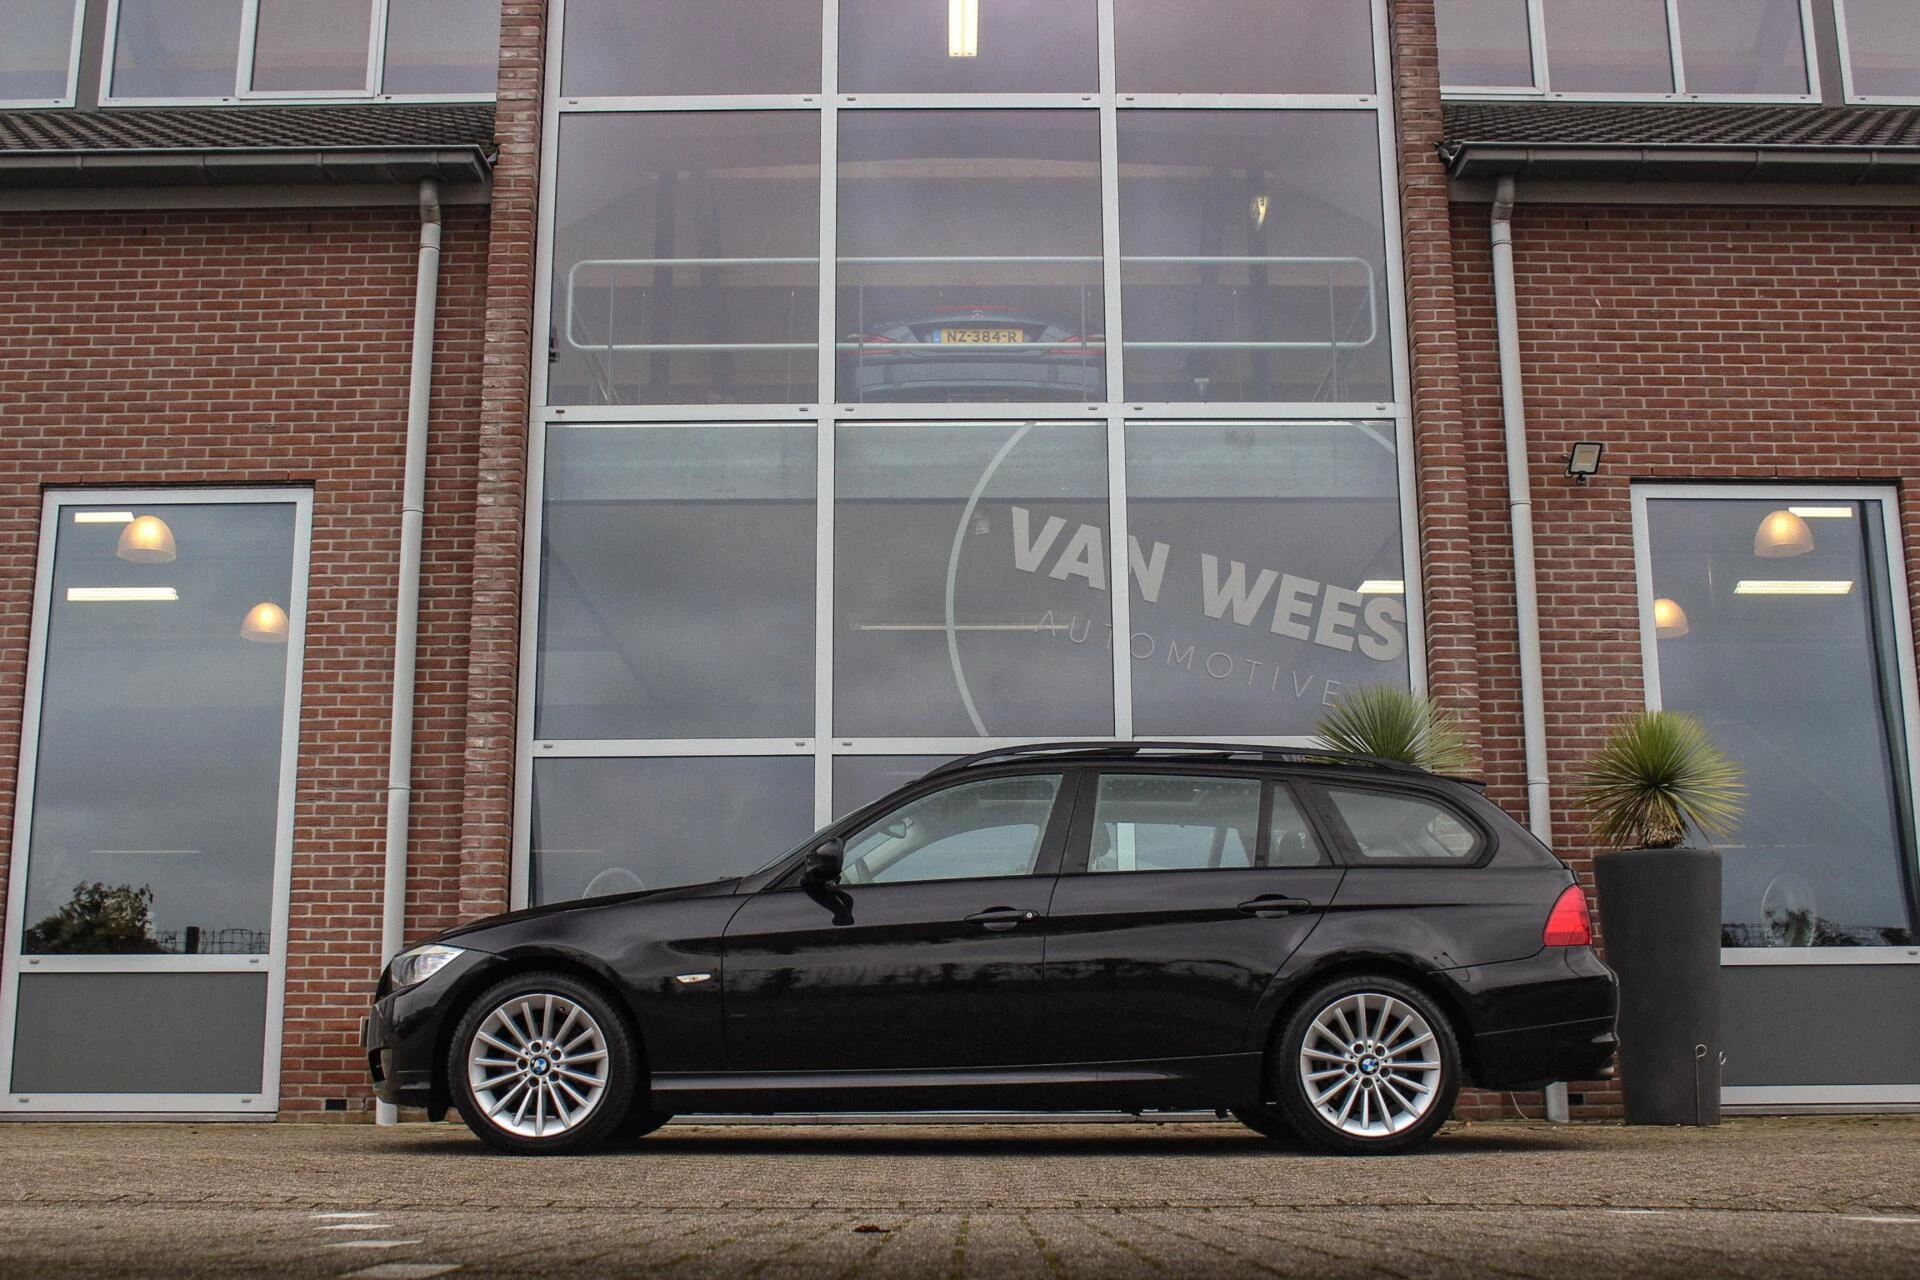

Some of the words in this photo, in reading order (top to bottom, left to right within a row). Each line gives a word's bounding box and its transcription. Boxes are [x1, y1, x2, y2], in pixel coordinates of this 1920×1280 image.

[947, 330, 1017, 343] NZ-384-R
[1011, 506, 1171, 604] VAN
[1200, 552, 1407, 662] WEES
